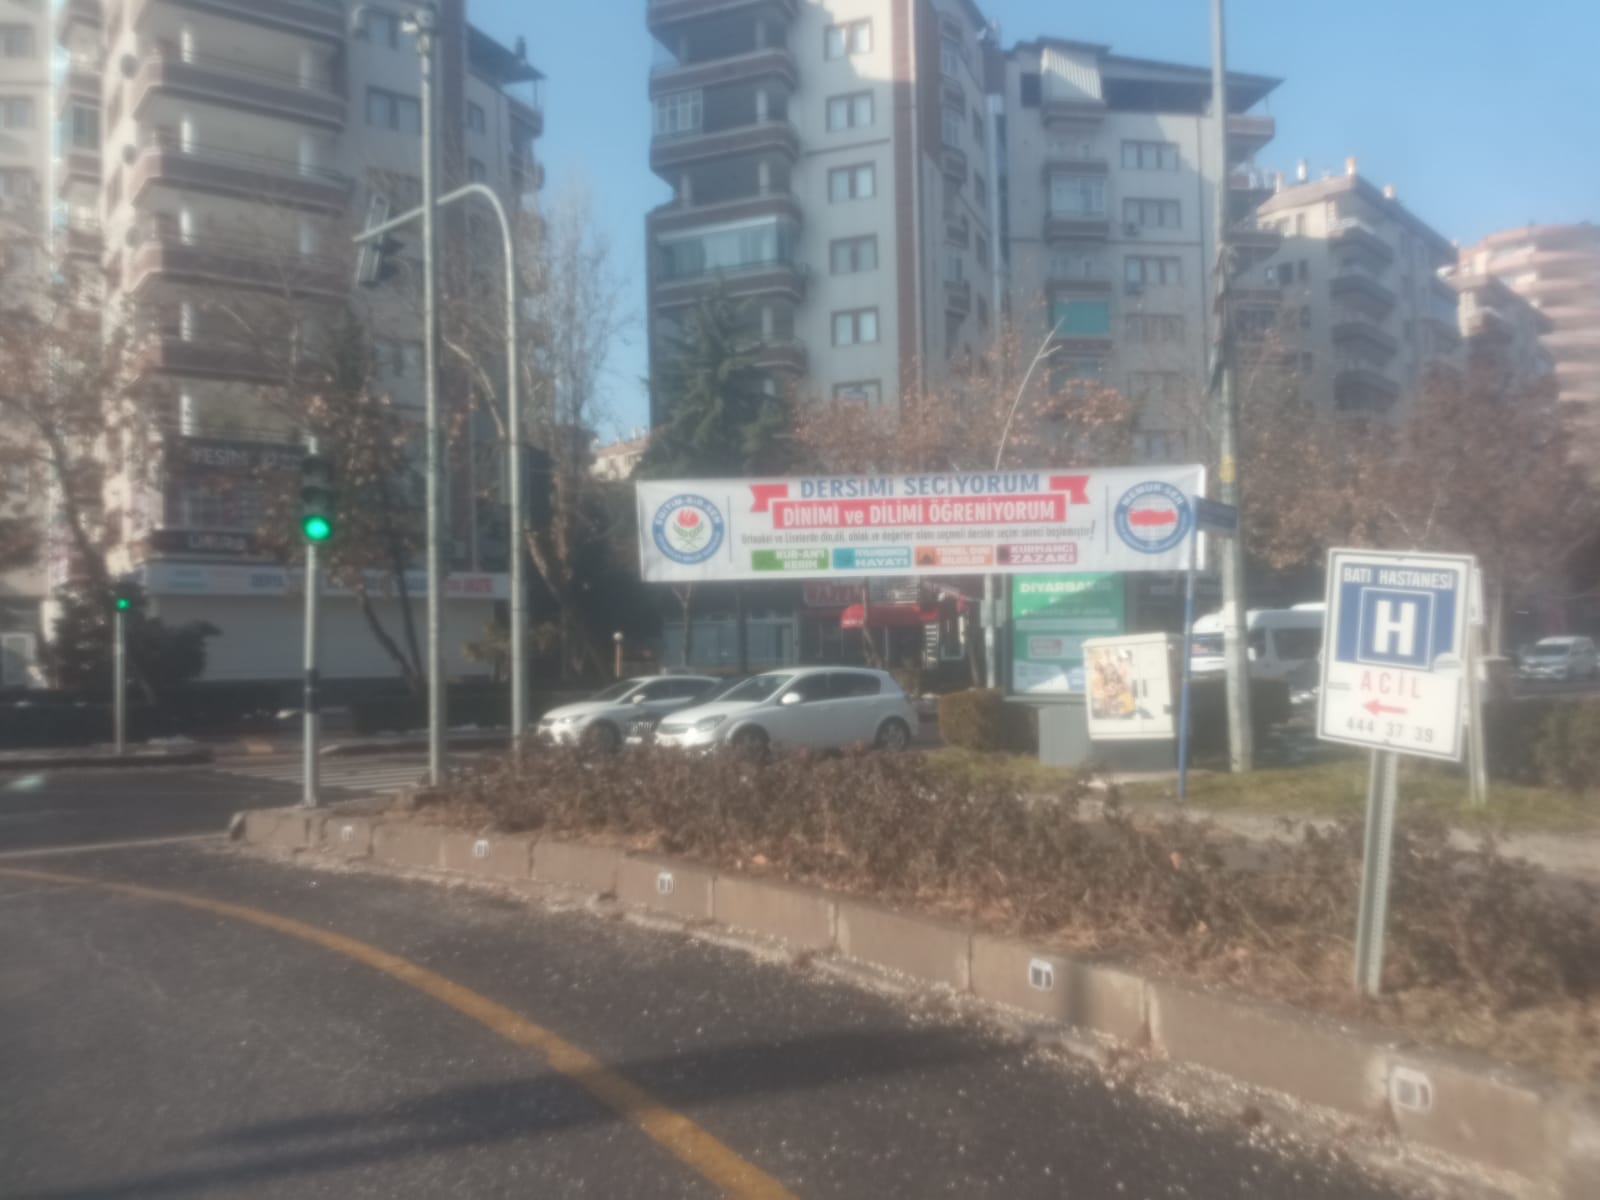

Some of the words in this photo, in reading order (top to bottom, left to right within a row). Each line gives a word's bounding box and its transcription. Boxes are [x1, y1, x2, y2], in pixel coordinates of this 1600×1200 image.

[783, 503, 840, 526] DİNİMİ
[845, 509, 864, 524] ve
[870, 500, 922, 523] DİLİMİ
[929, 497, 1055, 522] ÖĞRENİYORUM
[1344, 566, 1372, 584] BATI
[1378, 568, 1453, 590] HASTANESİ
[1373, 599, 1418, 657] H
[1346, 716, 1375, 735] 444
[1385, 721, 1404, 738] 37
[1415, 725, 1434, 744] 39
